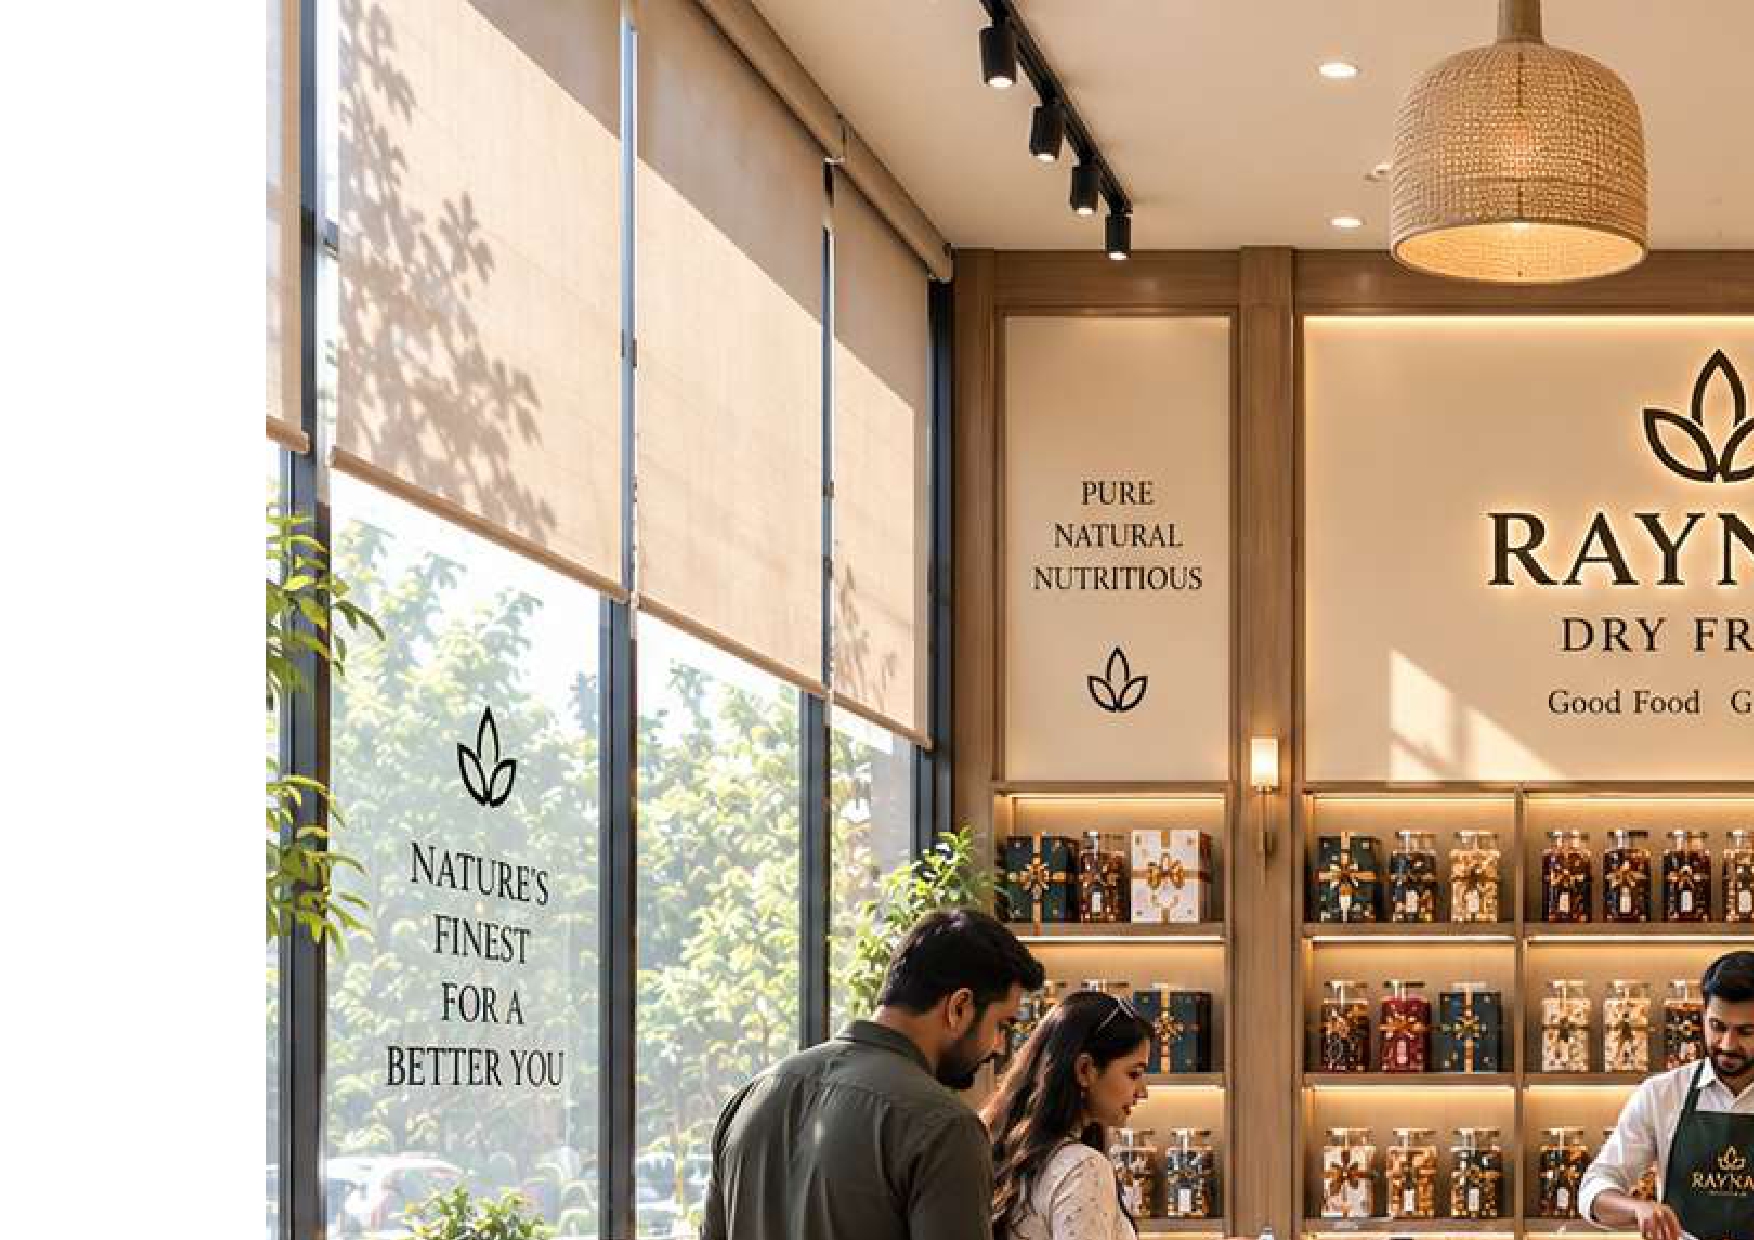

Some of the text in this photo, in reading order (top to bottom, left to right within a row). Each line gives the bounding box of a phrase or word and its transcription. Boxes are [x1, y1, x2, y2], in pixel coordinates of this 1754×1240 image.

[1081, 480, 1155, 506] PURE
[1053, 523, 1184, 549] NATURAL
[1034, 566, 1203, 590] NUTRITIOUS
[1562, 616, 1667, 654] DRY
[1548, 688, 1622, 715] Good
[1633, 688, 1701, 715] Food
[410, 842, 549, 906] NATURE'S
[432, 914, 531, 964] FINEST
[441, 982, 525, 1025] FOR A
[386, 1045, 565, 1087] BETTER YOU
